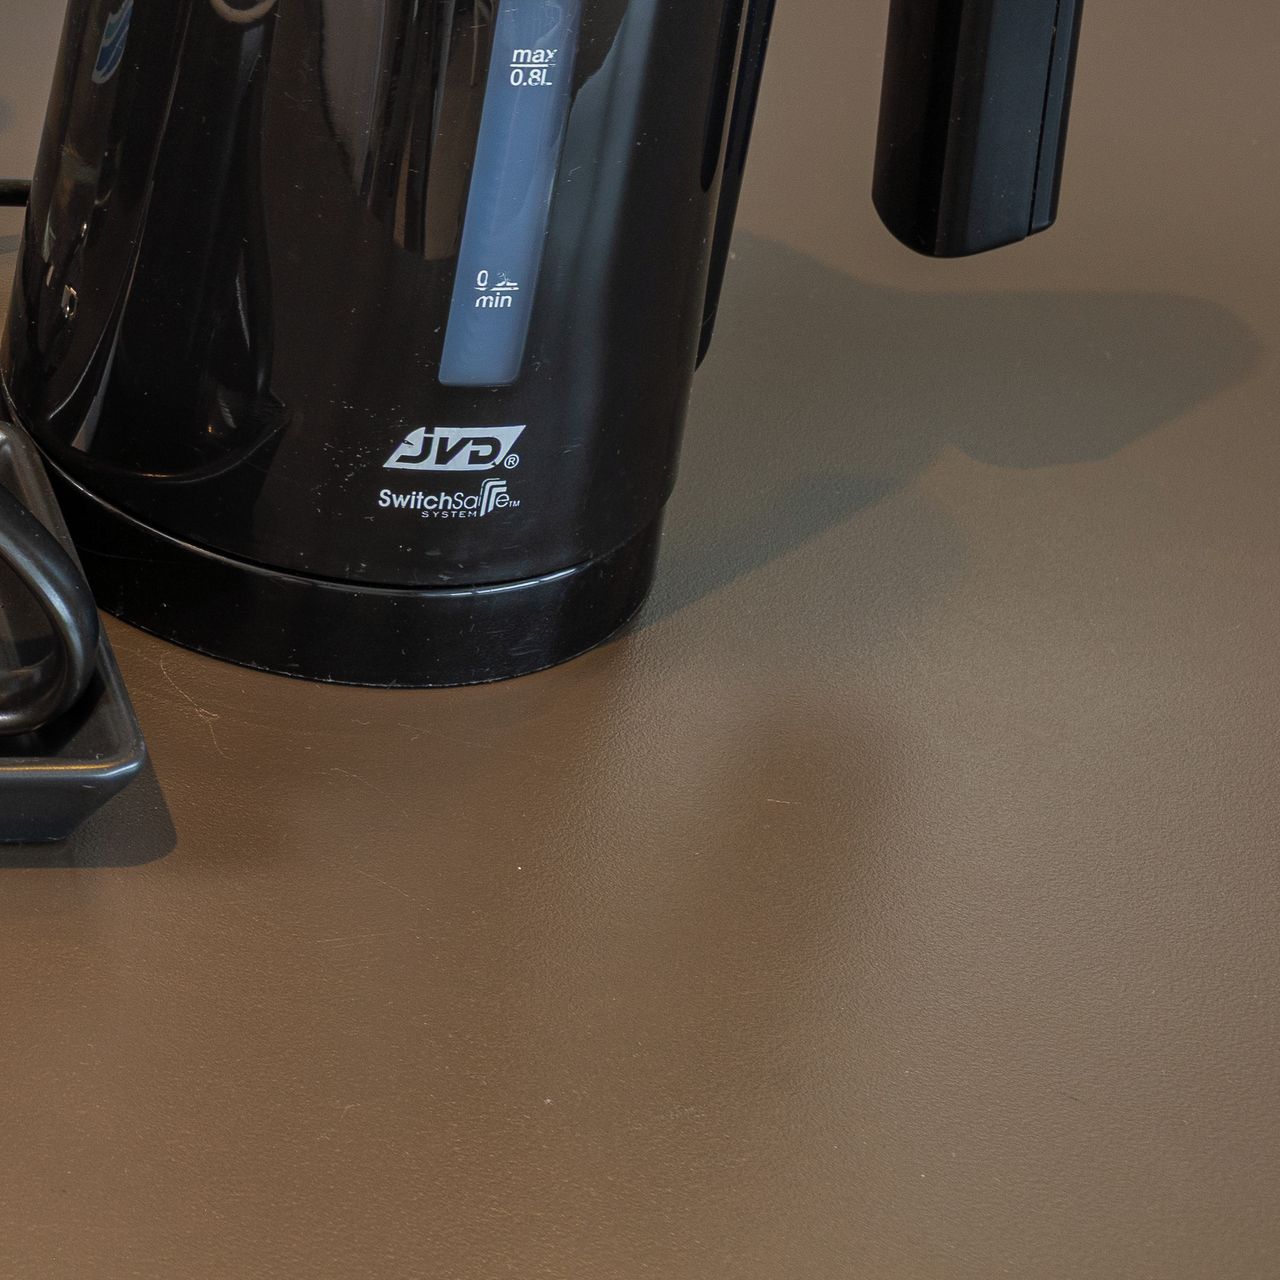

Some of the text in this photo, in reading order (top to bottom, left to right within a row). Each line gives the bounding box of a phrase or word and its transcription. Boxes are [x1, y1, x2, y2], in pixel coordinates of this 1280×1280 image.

[512, 48, 558, 63] max
[509, 68, 553, 86] 0.8L
[474, 291, 513, 308] min
[390, 426, 510, 468] JVD
[421, 510, 477, 518] SYSTEM
